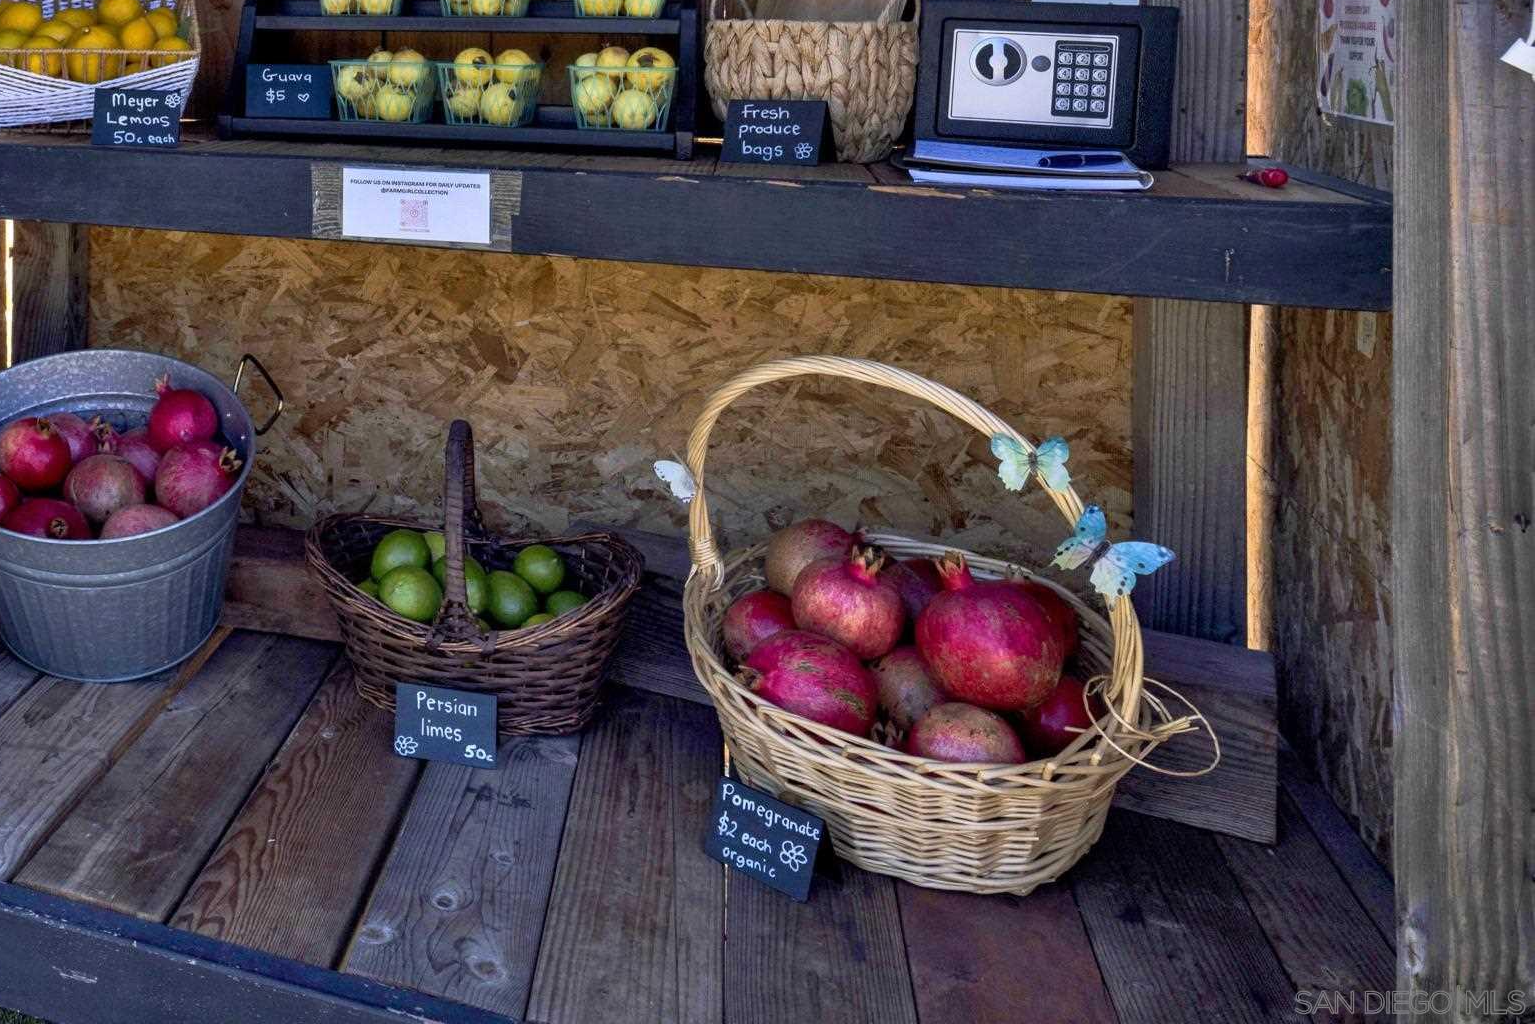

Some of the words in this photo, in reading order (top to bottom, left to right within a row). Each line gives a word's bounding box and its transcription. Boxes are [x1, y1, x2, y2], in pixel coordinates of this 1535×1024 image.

[262, 68, 312, 83] Guava
[112, 93, 159, 112] Meyer
[266, 90, 286, 104] $5
[106, 111, 170, 127] Lemons
[741, 104, 789, 120] Fresh
[148, 133, 175, 144] each
[738, 124, 801, 138] produce
[742, 140, 783, 161] bags
[416, 690, 477, 717] Persian
[421, 718, 462, 742] limes
[722, 783, 820, 841] Pomegranate
[718, 810, 738, 837] $2
[741, 833, 772, 854] each
[722, 847, 776, 878] organic
